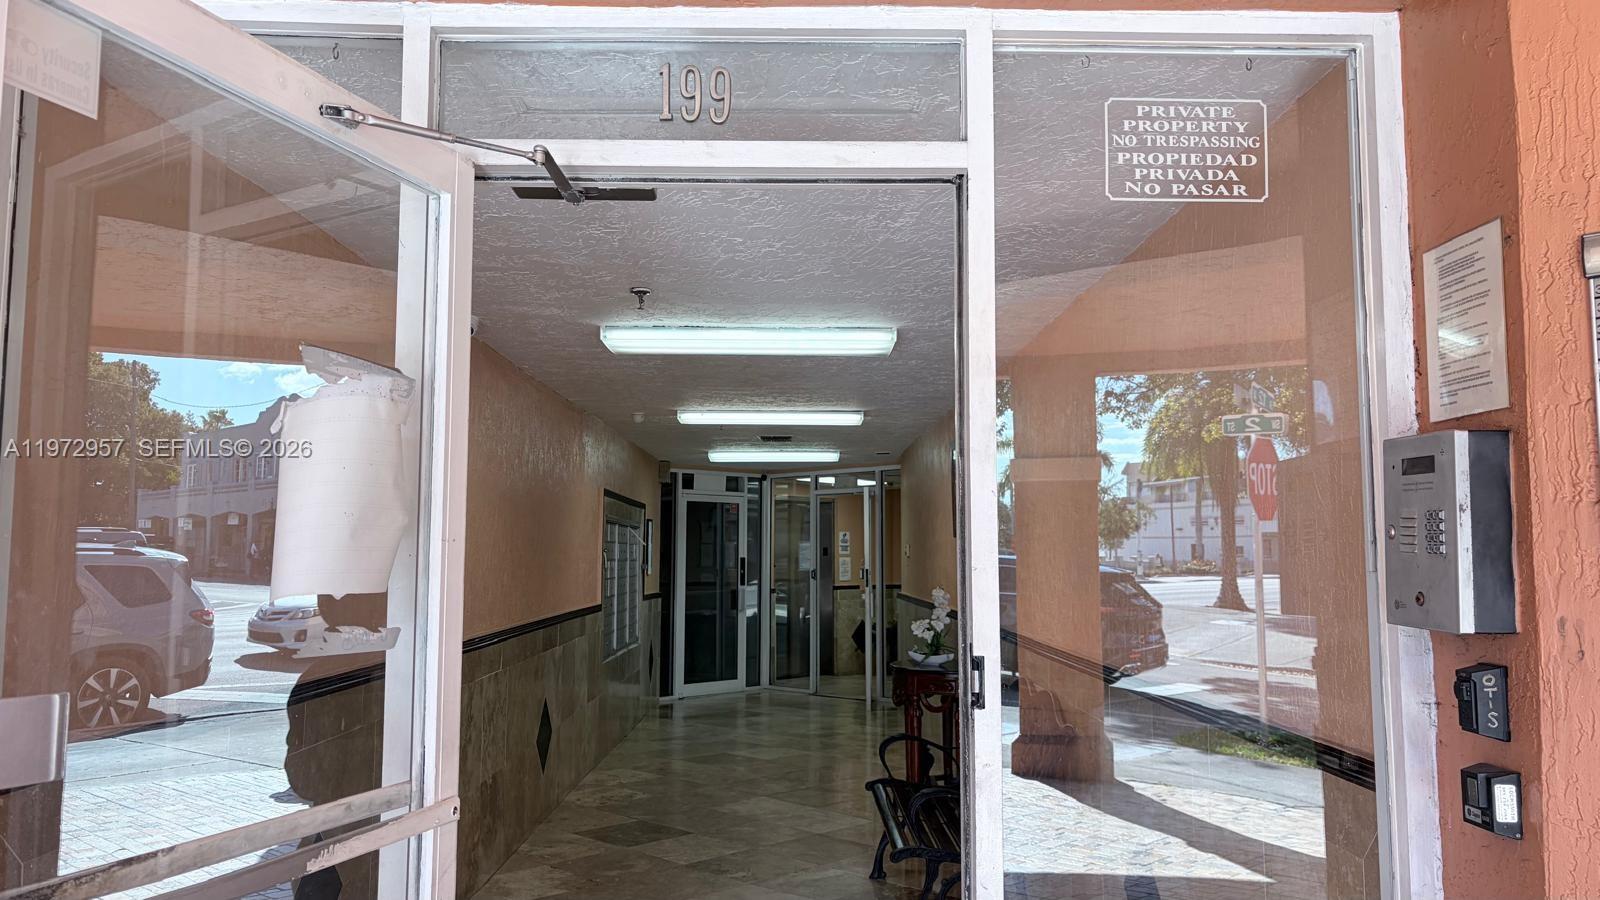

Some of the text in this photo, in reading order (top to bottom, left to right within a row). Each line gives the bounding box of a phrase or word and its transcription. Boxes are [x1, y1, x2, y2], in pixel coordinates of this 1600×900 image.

[659, 63, 732, 125] 199
[1136, 105, 1236, 119] PRIVATE
[1122, 119, 1250, 133] PROPERTY
[1112, 134, 1261, 148] NO TRESPASSING
[1117, 152, 1258, 167] PROPIEDAD
[1134, 168, 1240, 181] PRIVADA
[1124, 181, 1249, 197] NO PASAR
